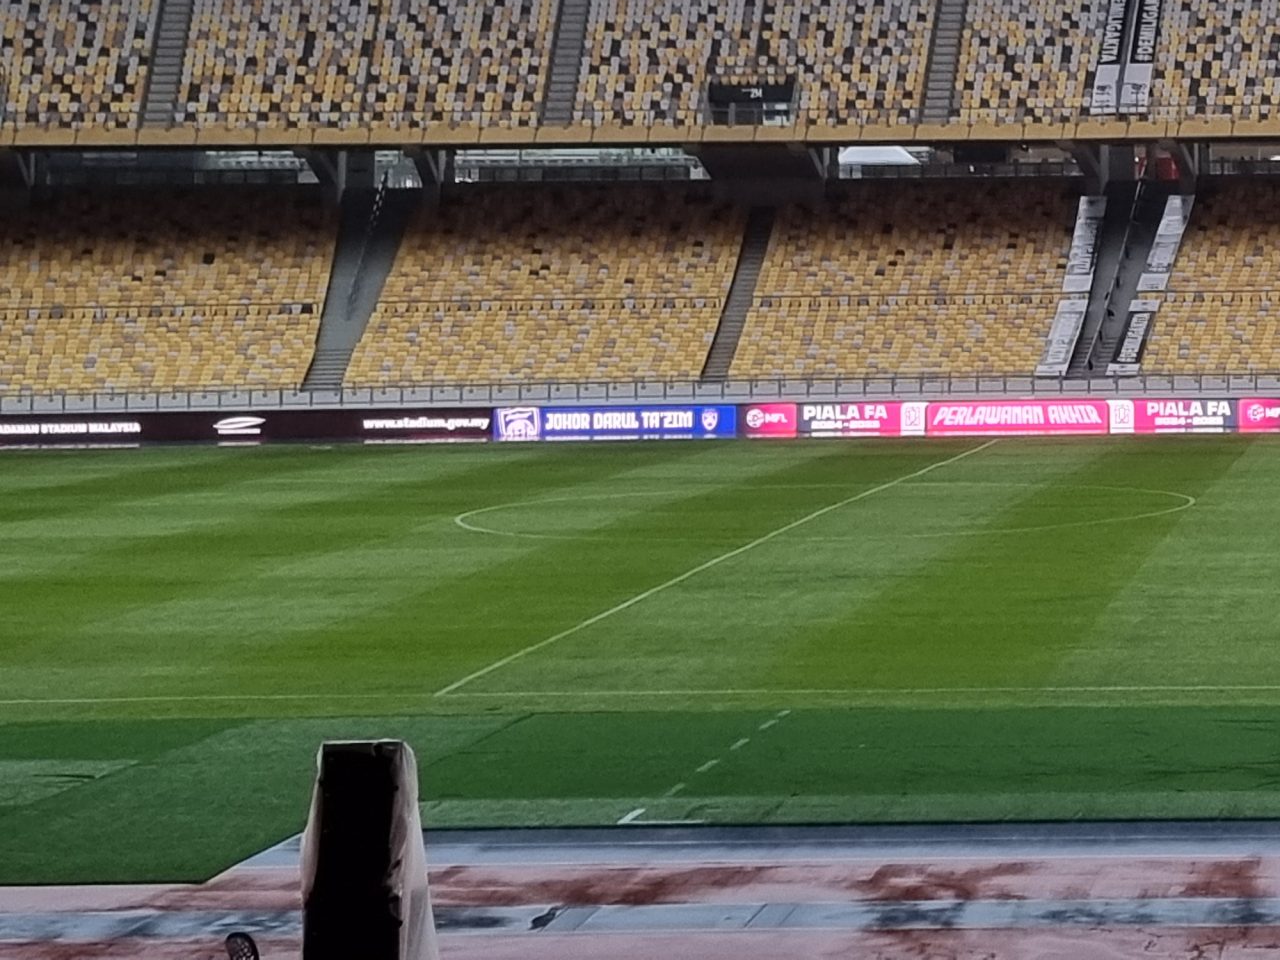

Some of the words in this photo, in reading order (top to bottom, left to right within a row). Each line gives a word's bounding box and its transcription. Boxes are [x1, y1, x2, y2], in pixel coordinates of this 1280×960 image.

[803, 404, 860, 420] PIALA
[864, 404, 888, 419] FA
[933, 405, 1045, 425] PERLAWANAN
[1048, 404, 1103, 424] AKHIR
[1147, 400, 1203, 416] PIALA
[1207, 400, 1231, 416] FA
[41, 422, 88, 434] STADIUM
[88, 421, 142, 434] MALAYSIA
[363, 416, 490, 430] www.stadium.gov.my
[545, 412, 590, 430] JOHOR
[593, 411, 639, 429] DARUL
[641, 411, 693, 428] TA'ZIM
